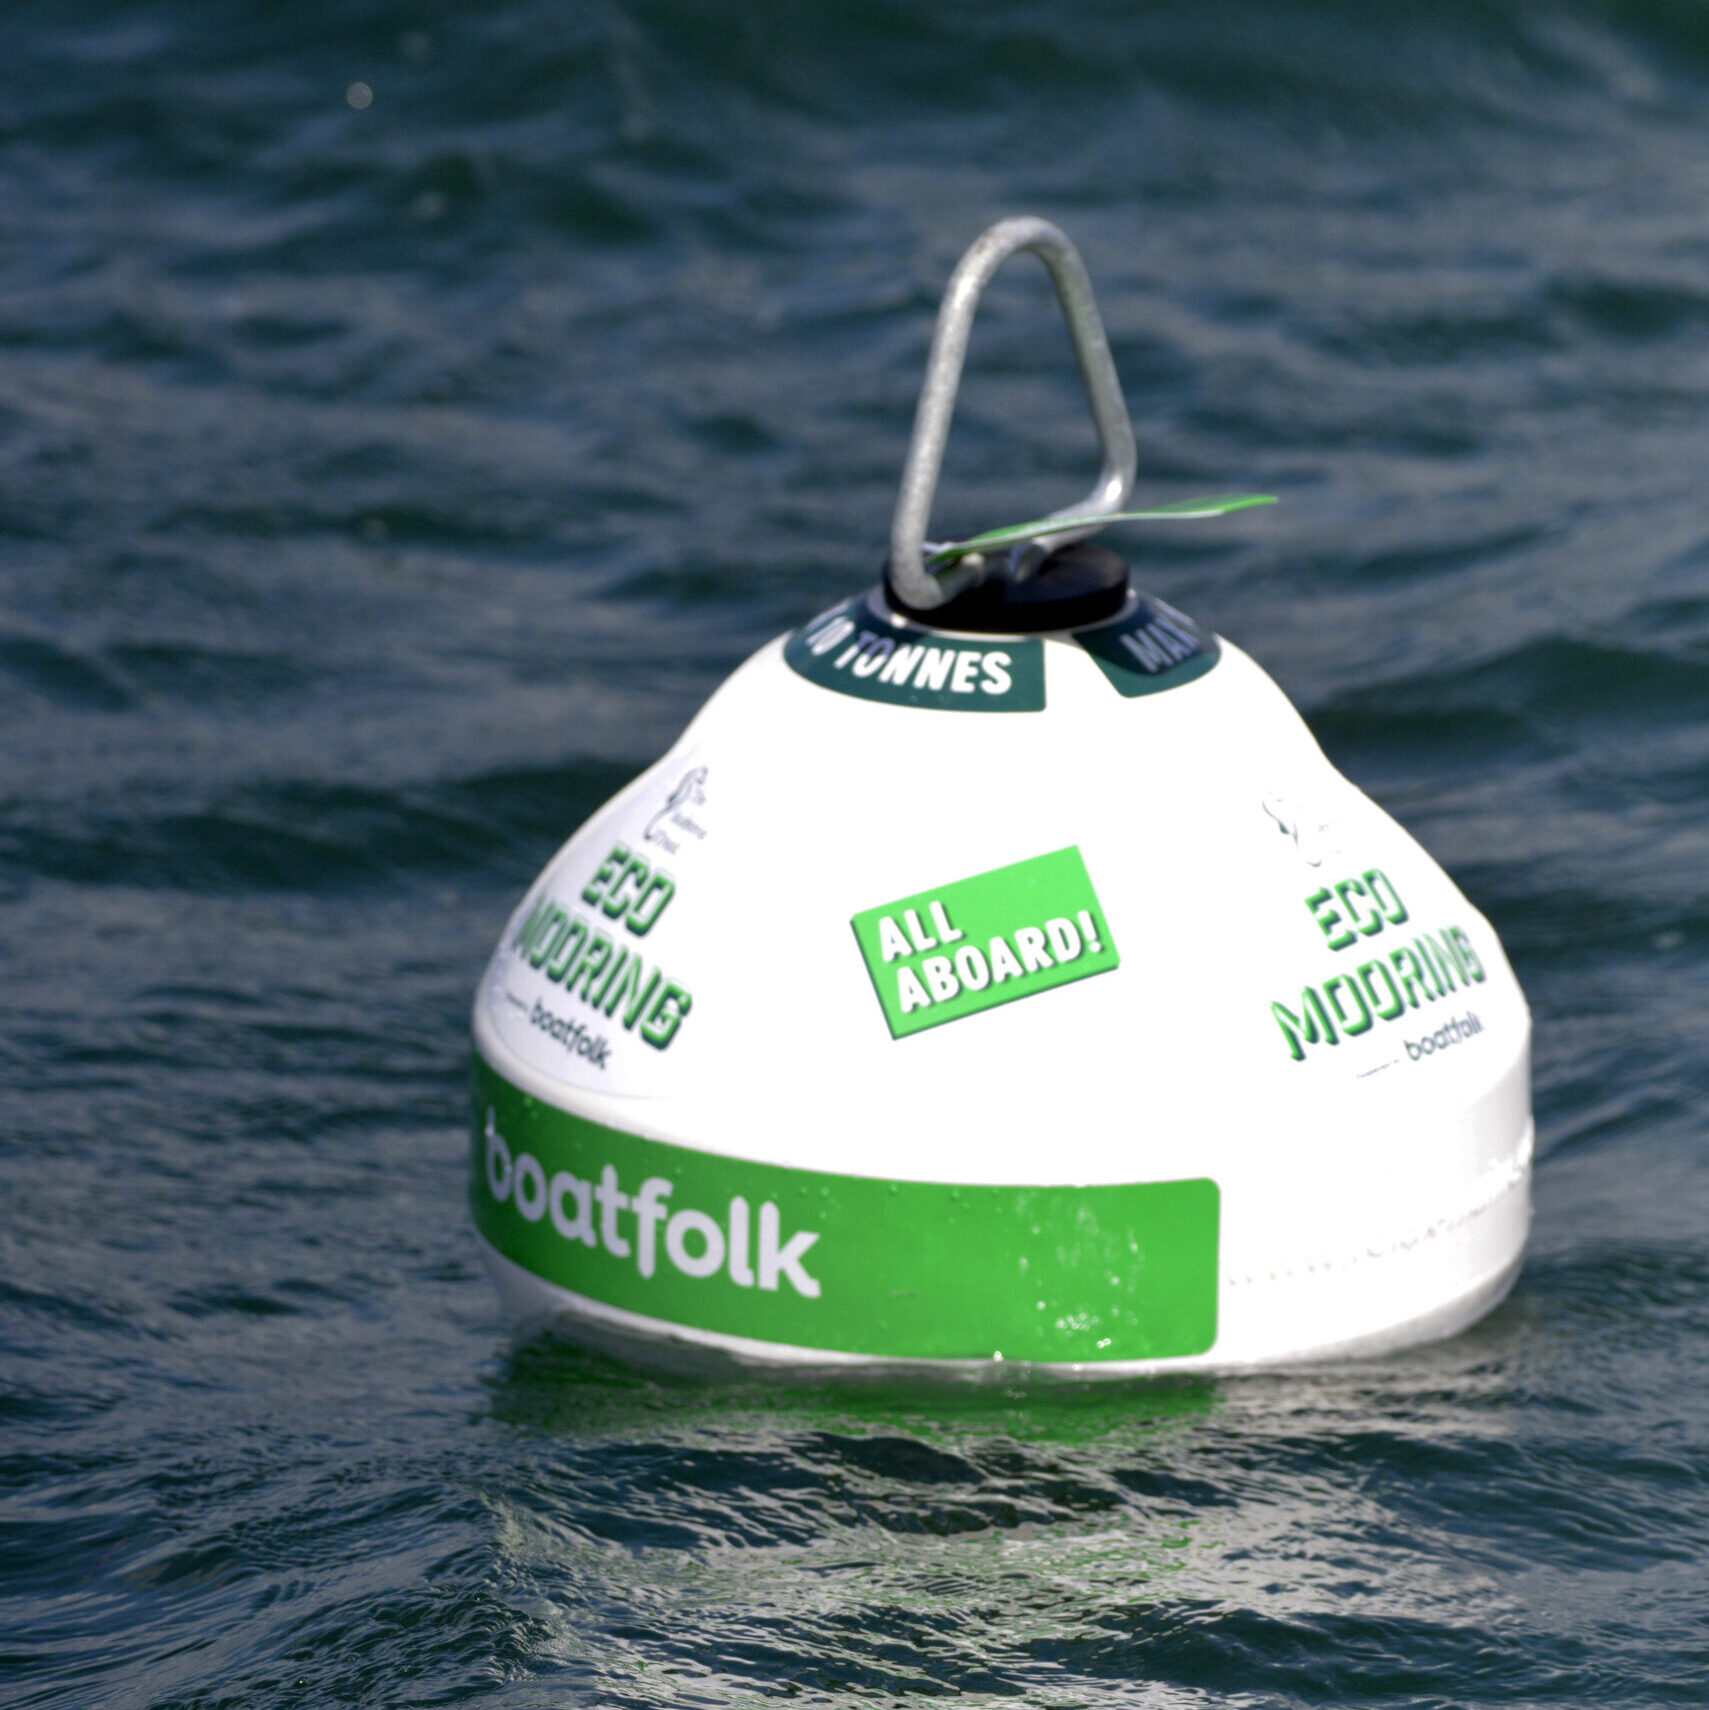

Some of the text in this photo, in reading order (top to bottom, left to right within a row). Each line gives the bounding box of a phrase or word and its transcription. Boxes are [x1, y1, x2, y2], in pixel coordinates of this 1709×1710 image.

[832, 629, 1013, 695] TONNES
[581, 841, 676, 938] ECO
[879, 900, 964, 963] ALL
[1303, 867, 1410, 952] ECO
[896, 910, 1103, 1014] ABOARD!
[1269, 924, 1487, 1062] MOORING
[529, 997, 613, 1070] boatfolk
[485, 1105, 822, 1299] boatfolk
